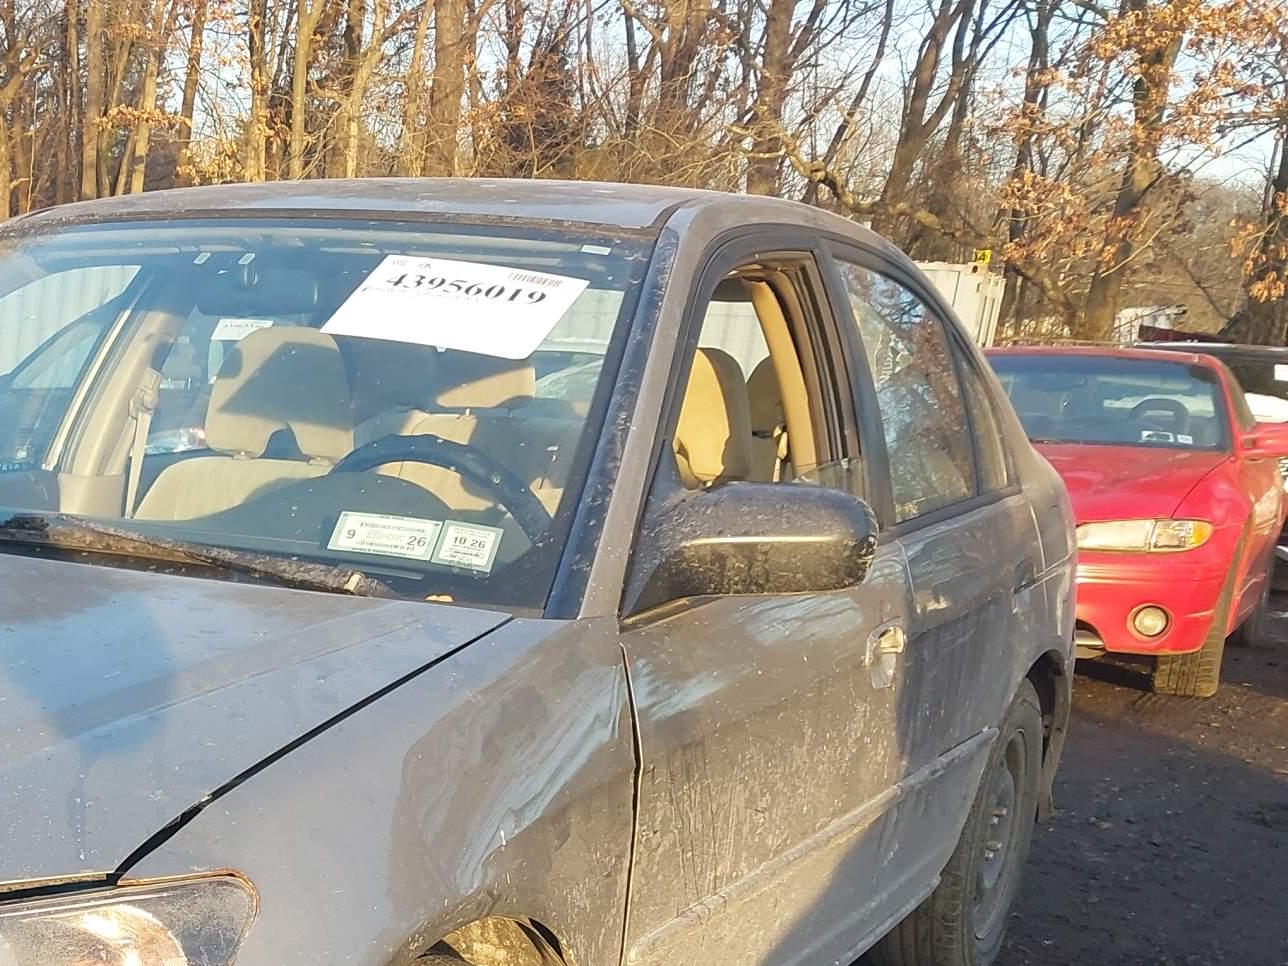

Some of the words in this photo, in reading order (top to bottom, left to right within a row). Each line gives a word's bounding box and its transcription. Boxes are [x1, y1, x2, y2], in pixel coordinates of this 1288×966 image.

[385, 273, 548, 305] 43956019
[345, 529, 357, 540] 9
[406, 535, 428, 547] 26
[453, 536, 468, 545] 10
[470, 539, 487, 549] 26
